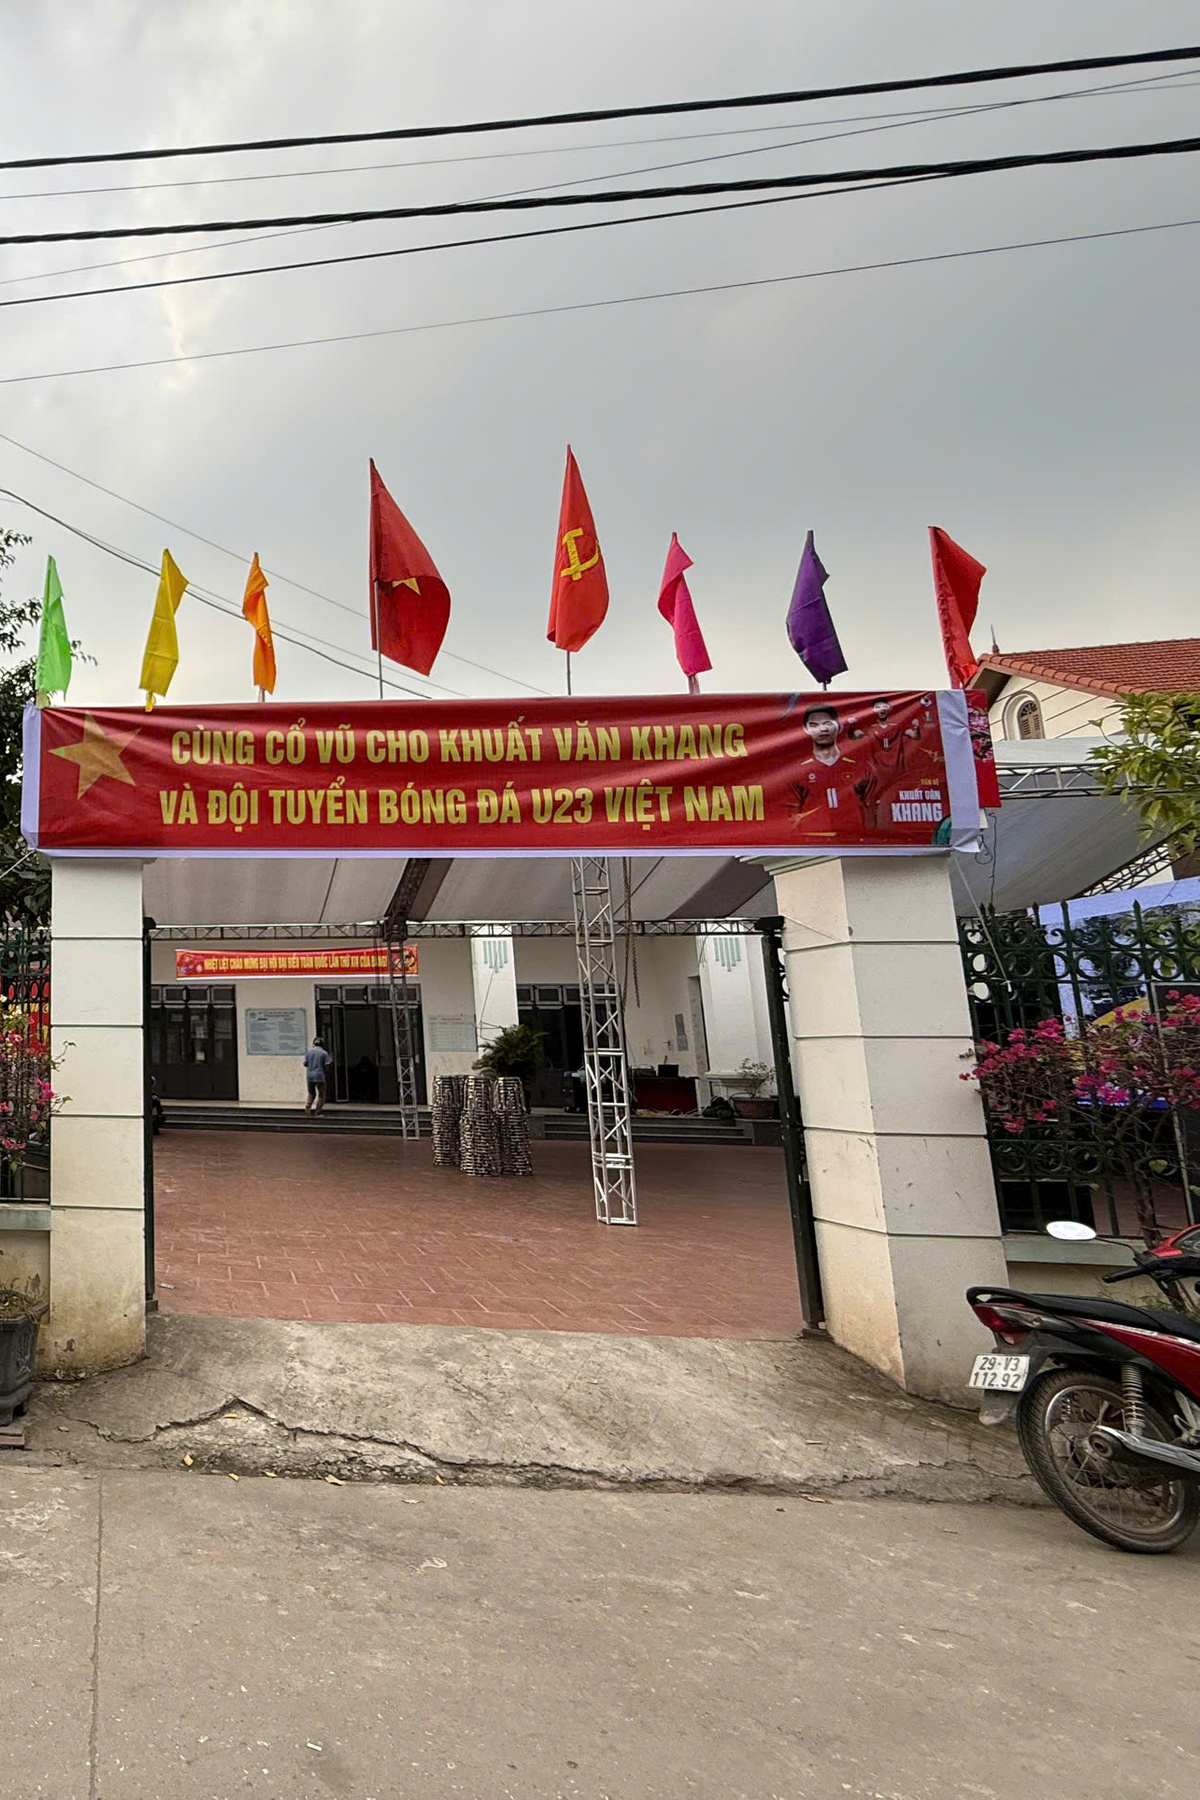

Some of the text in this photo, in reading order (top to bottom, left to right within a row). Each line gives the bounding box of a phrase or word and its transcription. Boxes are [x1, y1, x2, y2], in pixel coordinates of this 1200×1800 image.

[171, 716, 748, 765] CÙNG CỔ VŨ CHO KHUẤT VĂN KHANG
[159, 776, 765, 832] VÀ ĐỘI TUYỂN BÓNG ĐÁ U23 VIỆT NAM
[891, 803, 943, 822] KHANG
[972, 1371, 1022, 1389] 112.92
